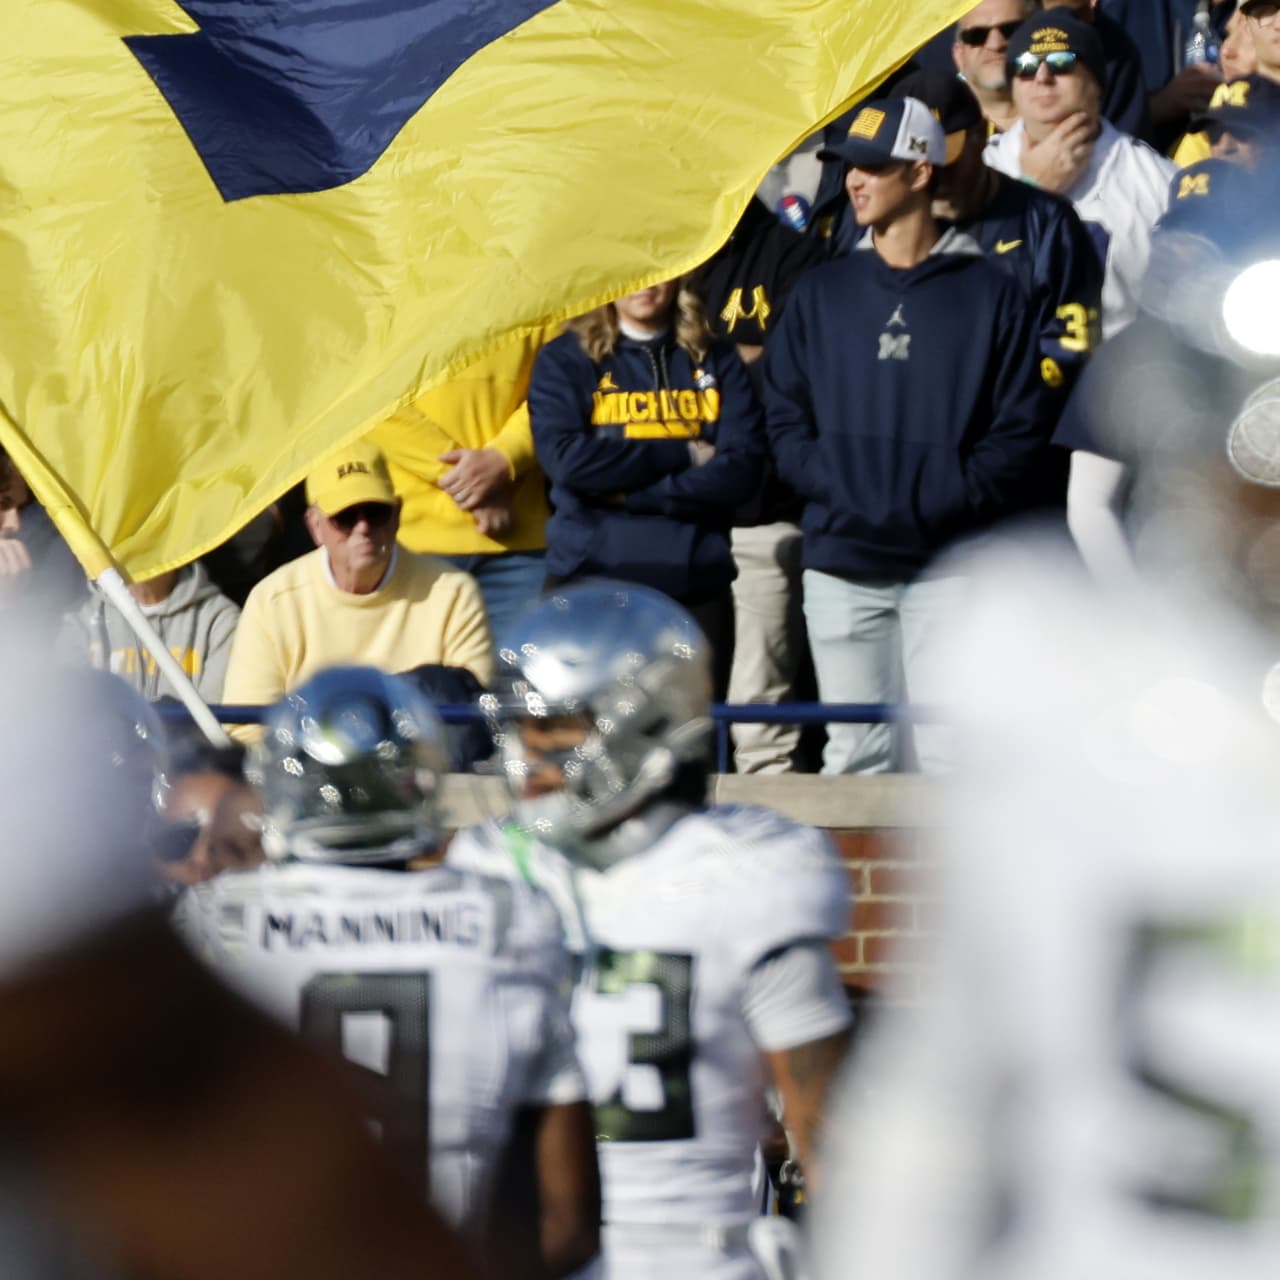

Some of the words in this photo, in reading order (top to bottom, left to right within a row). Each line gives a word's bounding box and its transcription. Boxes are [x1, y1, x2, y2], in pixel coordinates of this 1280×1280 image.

[1210, 81, 1249, 107] M
[909, 135, 928, 154] M
[1178, 173, 1209, 198] M
[878, 332, 910, 361] M
[262, 904, 486, 950] MANNING
